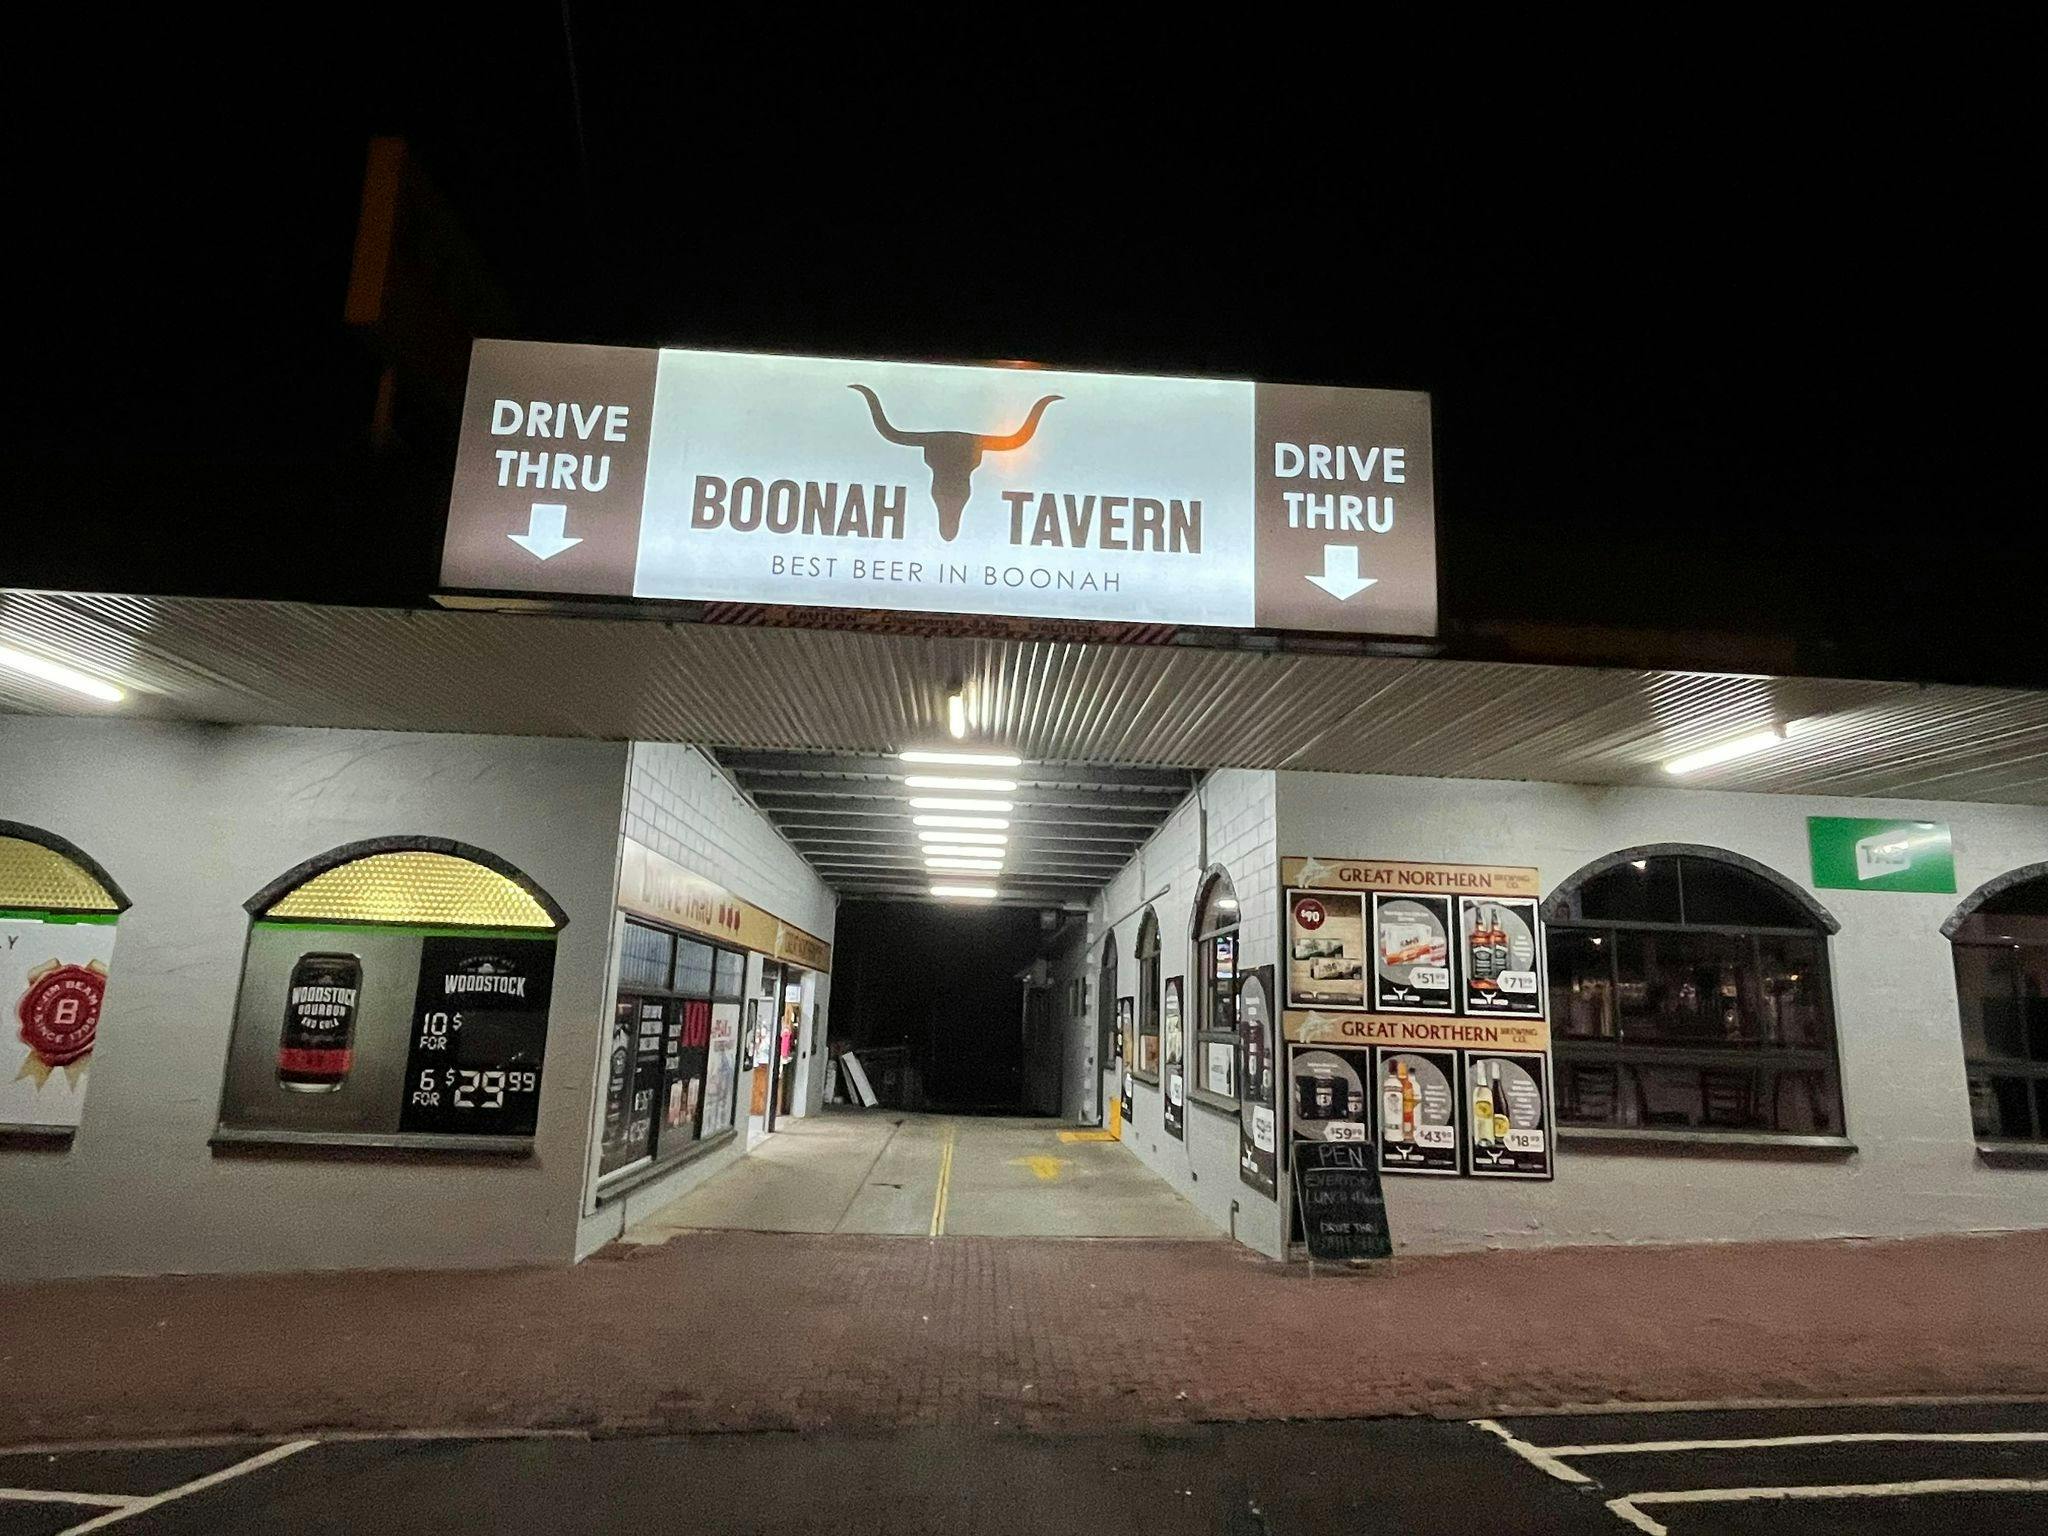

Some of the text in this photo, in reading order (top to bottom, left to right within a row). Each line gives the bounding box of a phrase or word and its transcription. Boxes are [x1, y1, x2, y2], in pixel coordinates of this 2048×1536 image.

[491, 399, 630, 442] DRIVE
[495, 449, 611, 493] THRU
[1275, 442, 1406, 484] DRIVE
[691, 475, 1201, 554] BOONAH TAVERN
[1283, 492, 1394, 534] THRU
[772, 555, 1120, 593] BEST BEER IN BOONAH
[1339, 867, 1395, 885] GREAT
[1398, 870, 1492, 888] NORTHERN
[64, 980, 99, 1006] BEAM
[291, 986, 357, 1008] WOODSTOCK
[445, 974, 527, 998] WOODSTOCK
[54, 998, 79, 1025] B
[423, 1012, 448, 1036] 10
[419, 1036, 448, 1051] FOR
[1341, 1020, 1399, 1039] GREAT
[1401, 1023, 1499, 1042] NORTHERN
[419, 1068, 436, 1091] 6
[412, 1091, 441, 1107] FOR
